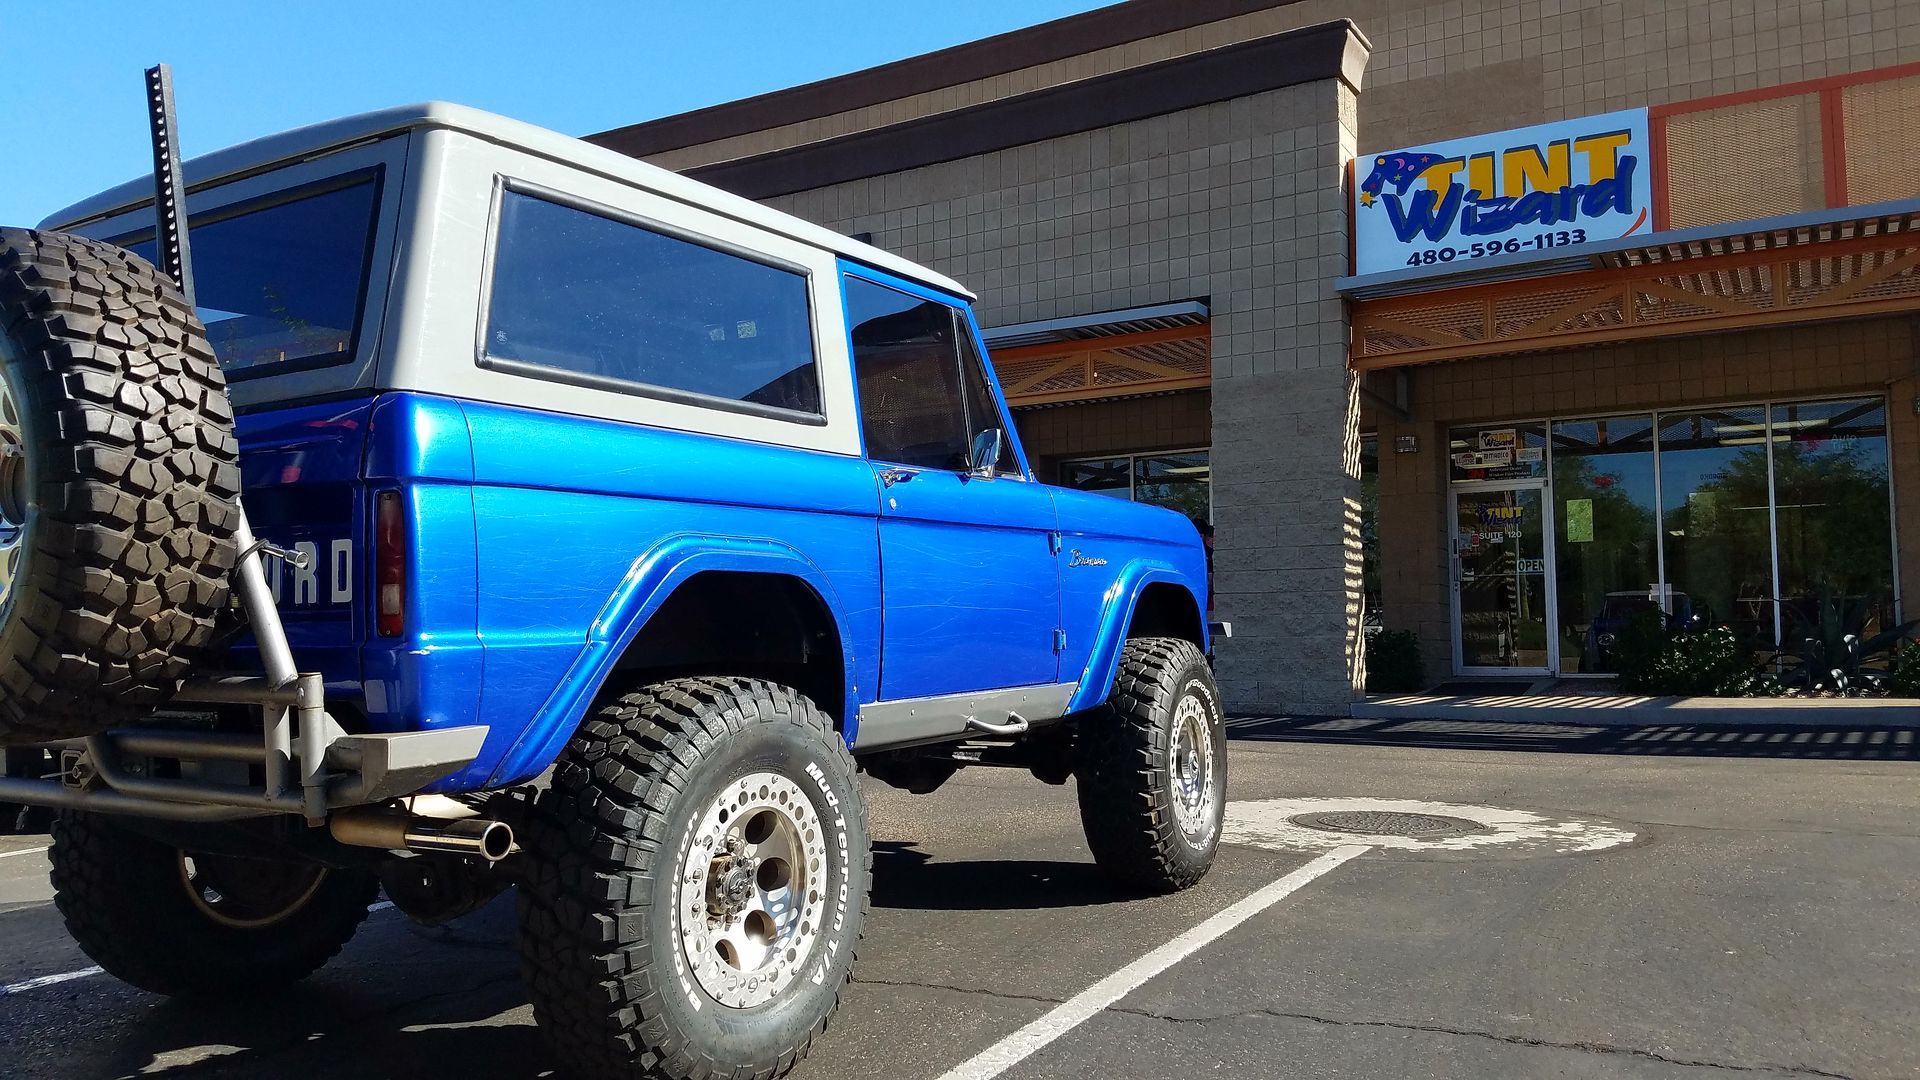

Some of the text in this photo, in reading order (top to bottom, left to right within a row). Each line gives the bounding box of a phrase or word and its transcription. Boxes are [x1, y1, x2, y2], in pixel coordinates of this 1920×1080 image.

[1418, 128, 1632, 211] TINT
[1381, 155, 1637, 243] Wizard
[1406, 229, 1587, 267] 480-596-1133
[1483, 437, 1516, 448] Wizard
[1487, 507, 1524, 518] TINT
[1480, 531, 1503, 540] SUITE
[1508, 531, 1522, 539] 120
[262, 539, 353, 605] ORD
[1518, 560, 1544, 571] OPEN
[805, 762, 848, 932] Mud-Terrain
[812, 938, 841, 986] T/A
